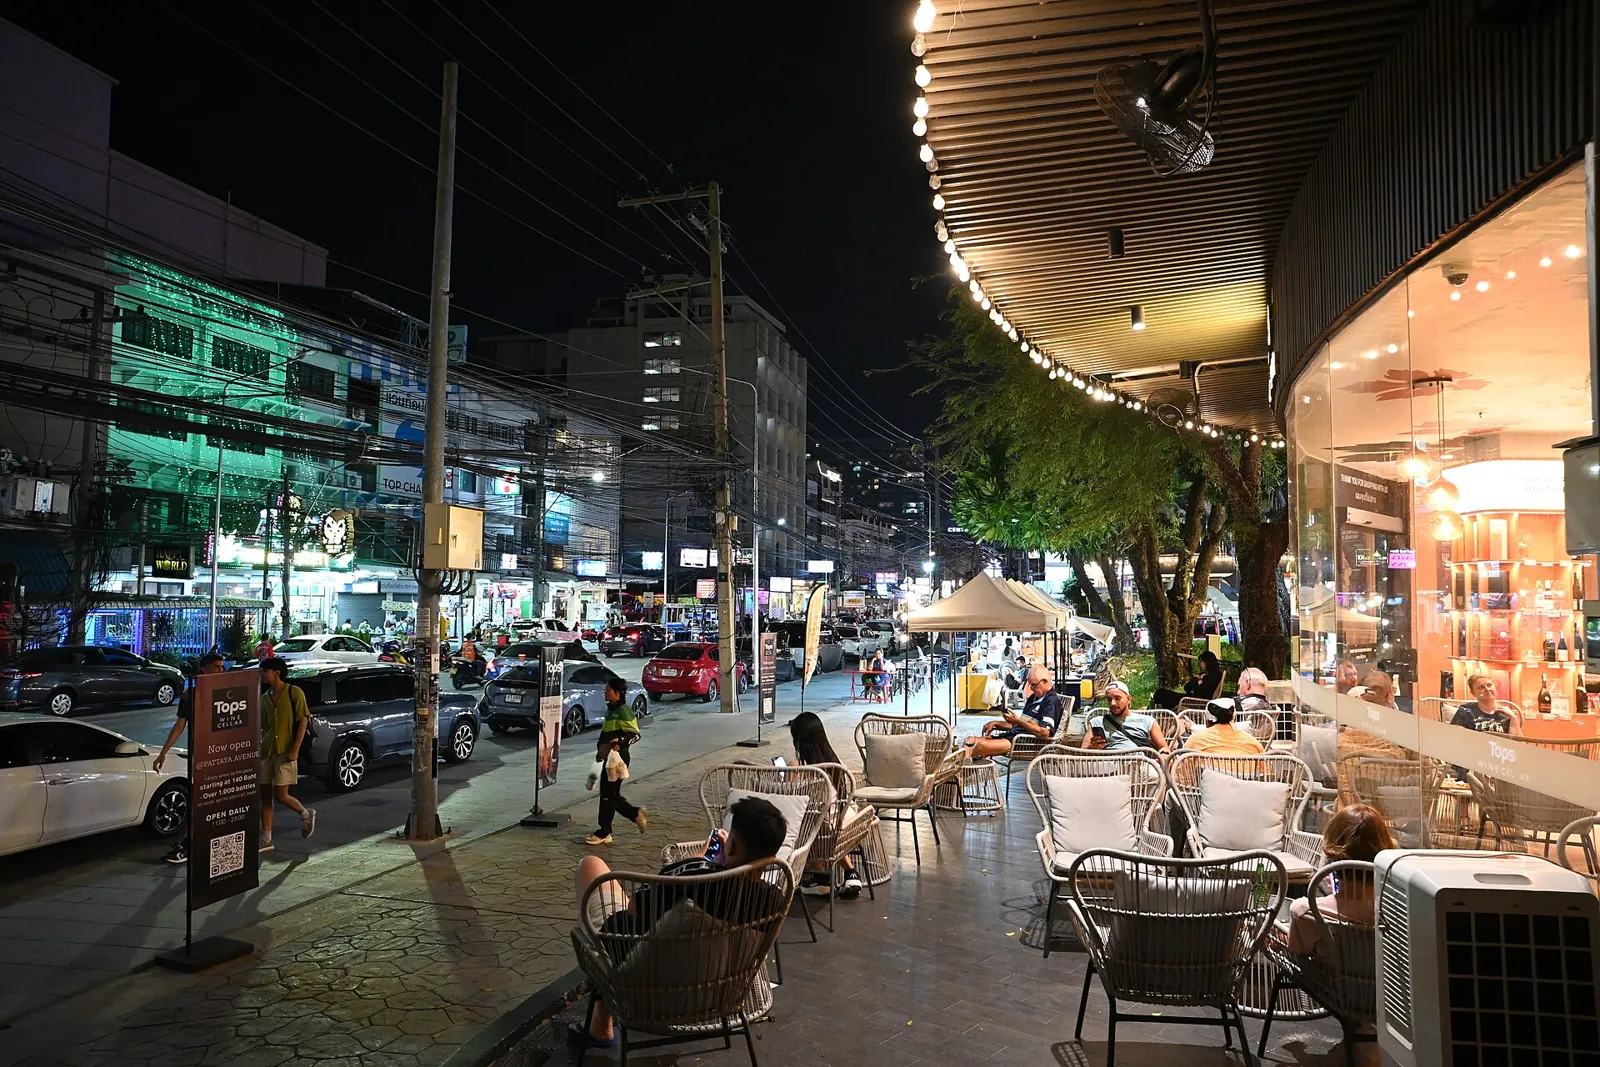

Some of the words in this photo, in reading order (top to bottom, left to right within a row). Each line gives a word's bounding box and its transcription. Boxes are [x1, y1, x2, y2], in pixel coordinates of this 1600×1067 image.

[383, 477, 402, 490] TOP
[403, 481, 422, 494] CHA
[156, 559, 188, 571] WORLD
[545, 661, 562, 676] Tops
[213, 700, 247, 715] Tops
[216, 720, 243, 729] CELLAR
[219, 715, 241, 723] WINE
[208, 744, 228, 755] Now
[229, 740, 251, 751] open
[1489, 741, 1515, 764] Tops
[196, 756, 233, 770] @PATTAYA
[233, 750, 260, 762] AVENUE
[200, 780, 224, 790] starting
[244, 773, 257, 781] Baht
[236, 783, 256, 792] bottles
[205, 811, 227, 822] OPEN
[228, 805, 250, 816] DAILY
